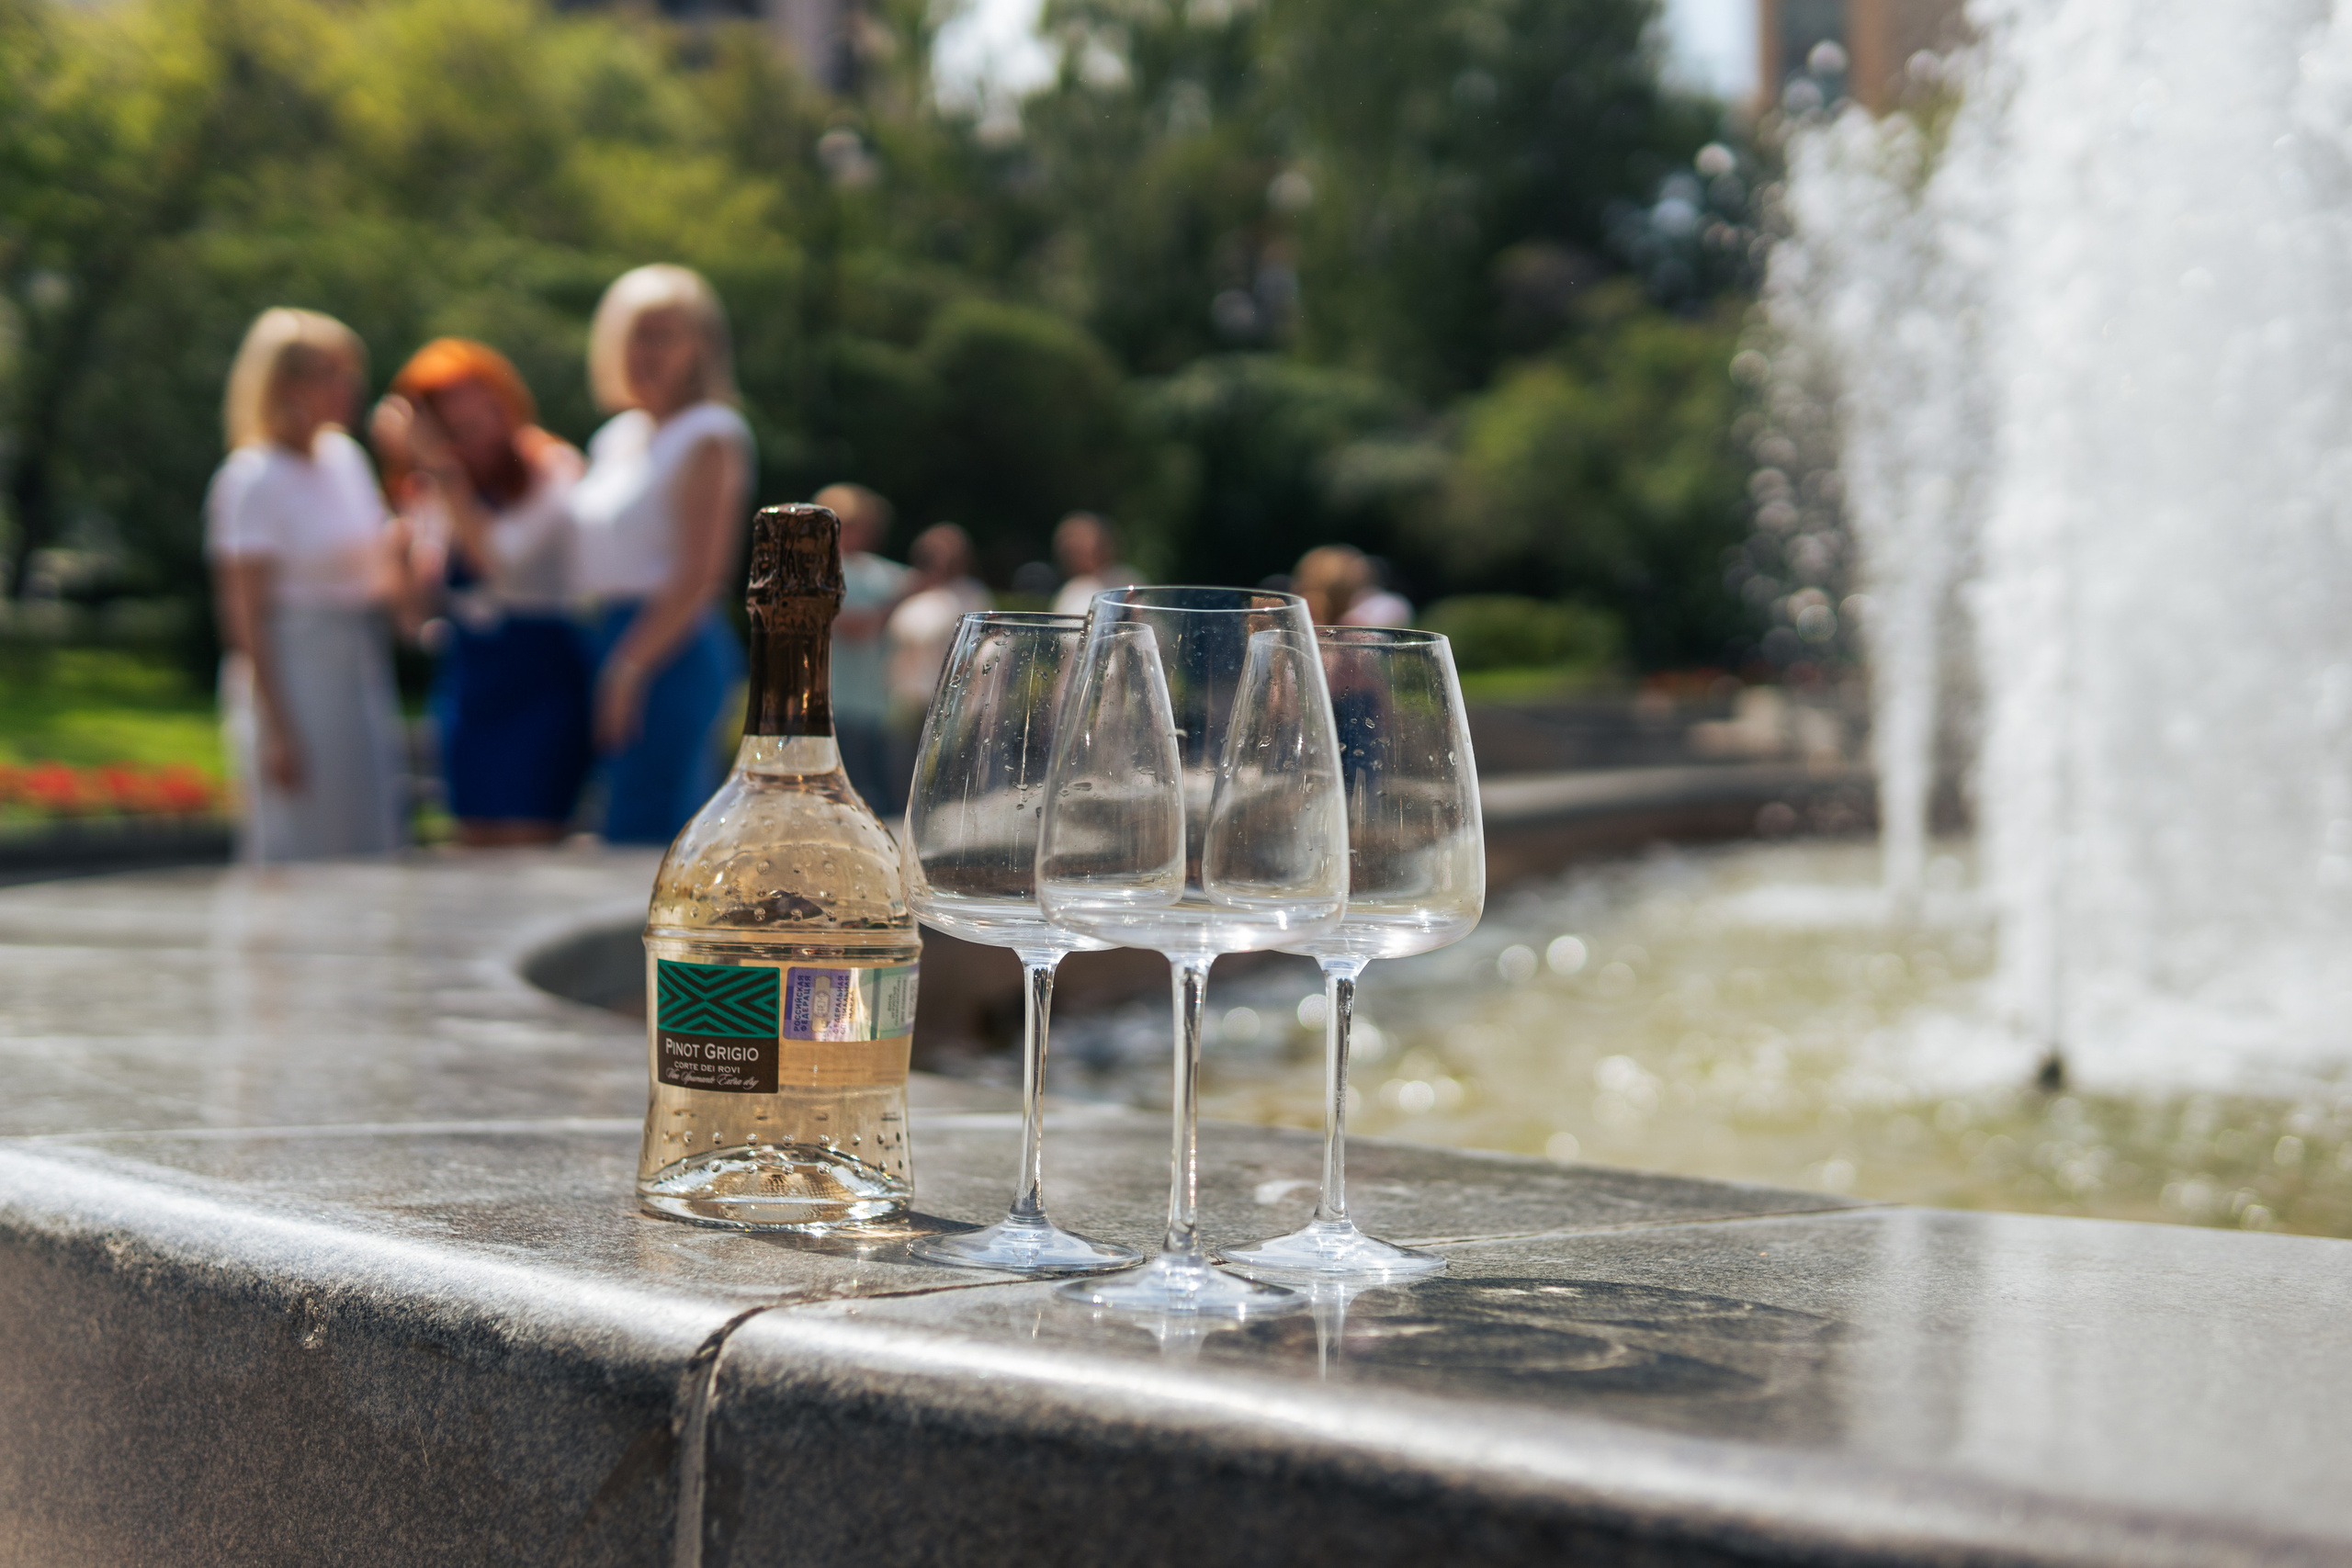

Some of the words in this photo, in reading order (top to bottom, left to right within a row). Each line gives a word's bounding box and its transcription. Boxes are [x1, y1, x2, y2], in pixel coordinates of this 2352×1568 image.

[794, 975, 805, 1032] РОССИЙСКАЯ
[800, 976, 811, 1032] ФЕДЕРАЦИЯ
[840, 976, 850, 1035] СПЦИАЛЬНАЯ
[665, 1038, 700, 1058] PINOT
[705, 1043, 759, 1062] GRIGIO
[673, 1061, 699, 1071] CORTE
[701, 1064, 715, 1072] DEI
[718, 1066, 741, 1074] ROVI
[717, 1073, 742, 1086] Extra
[742, 1077, 760, 1090] dry
